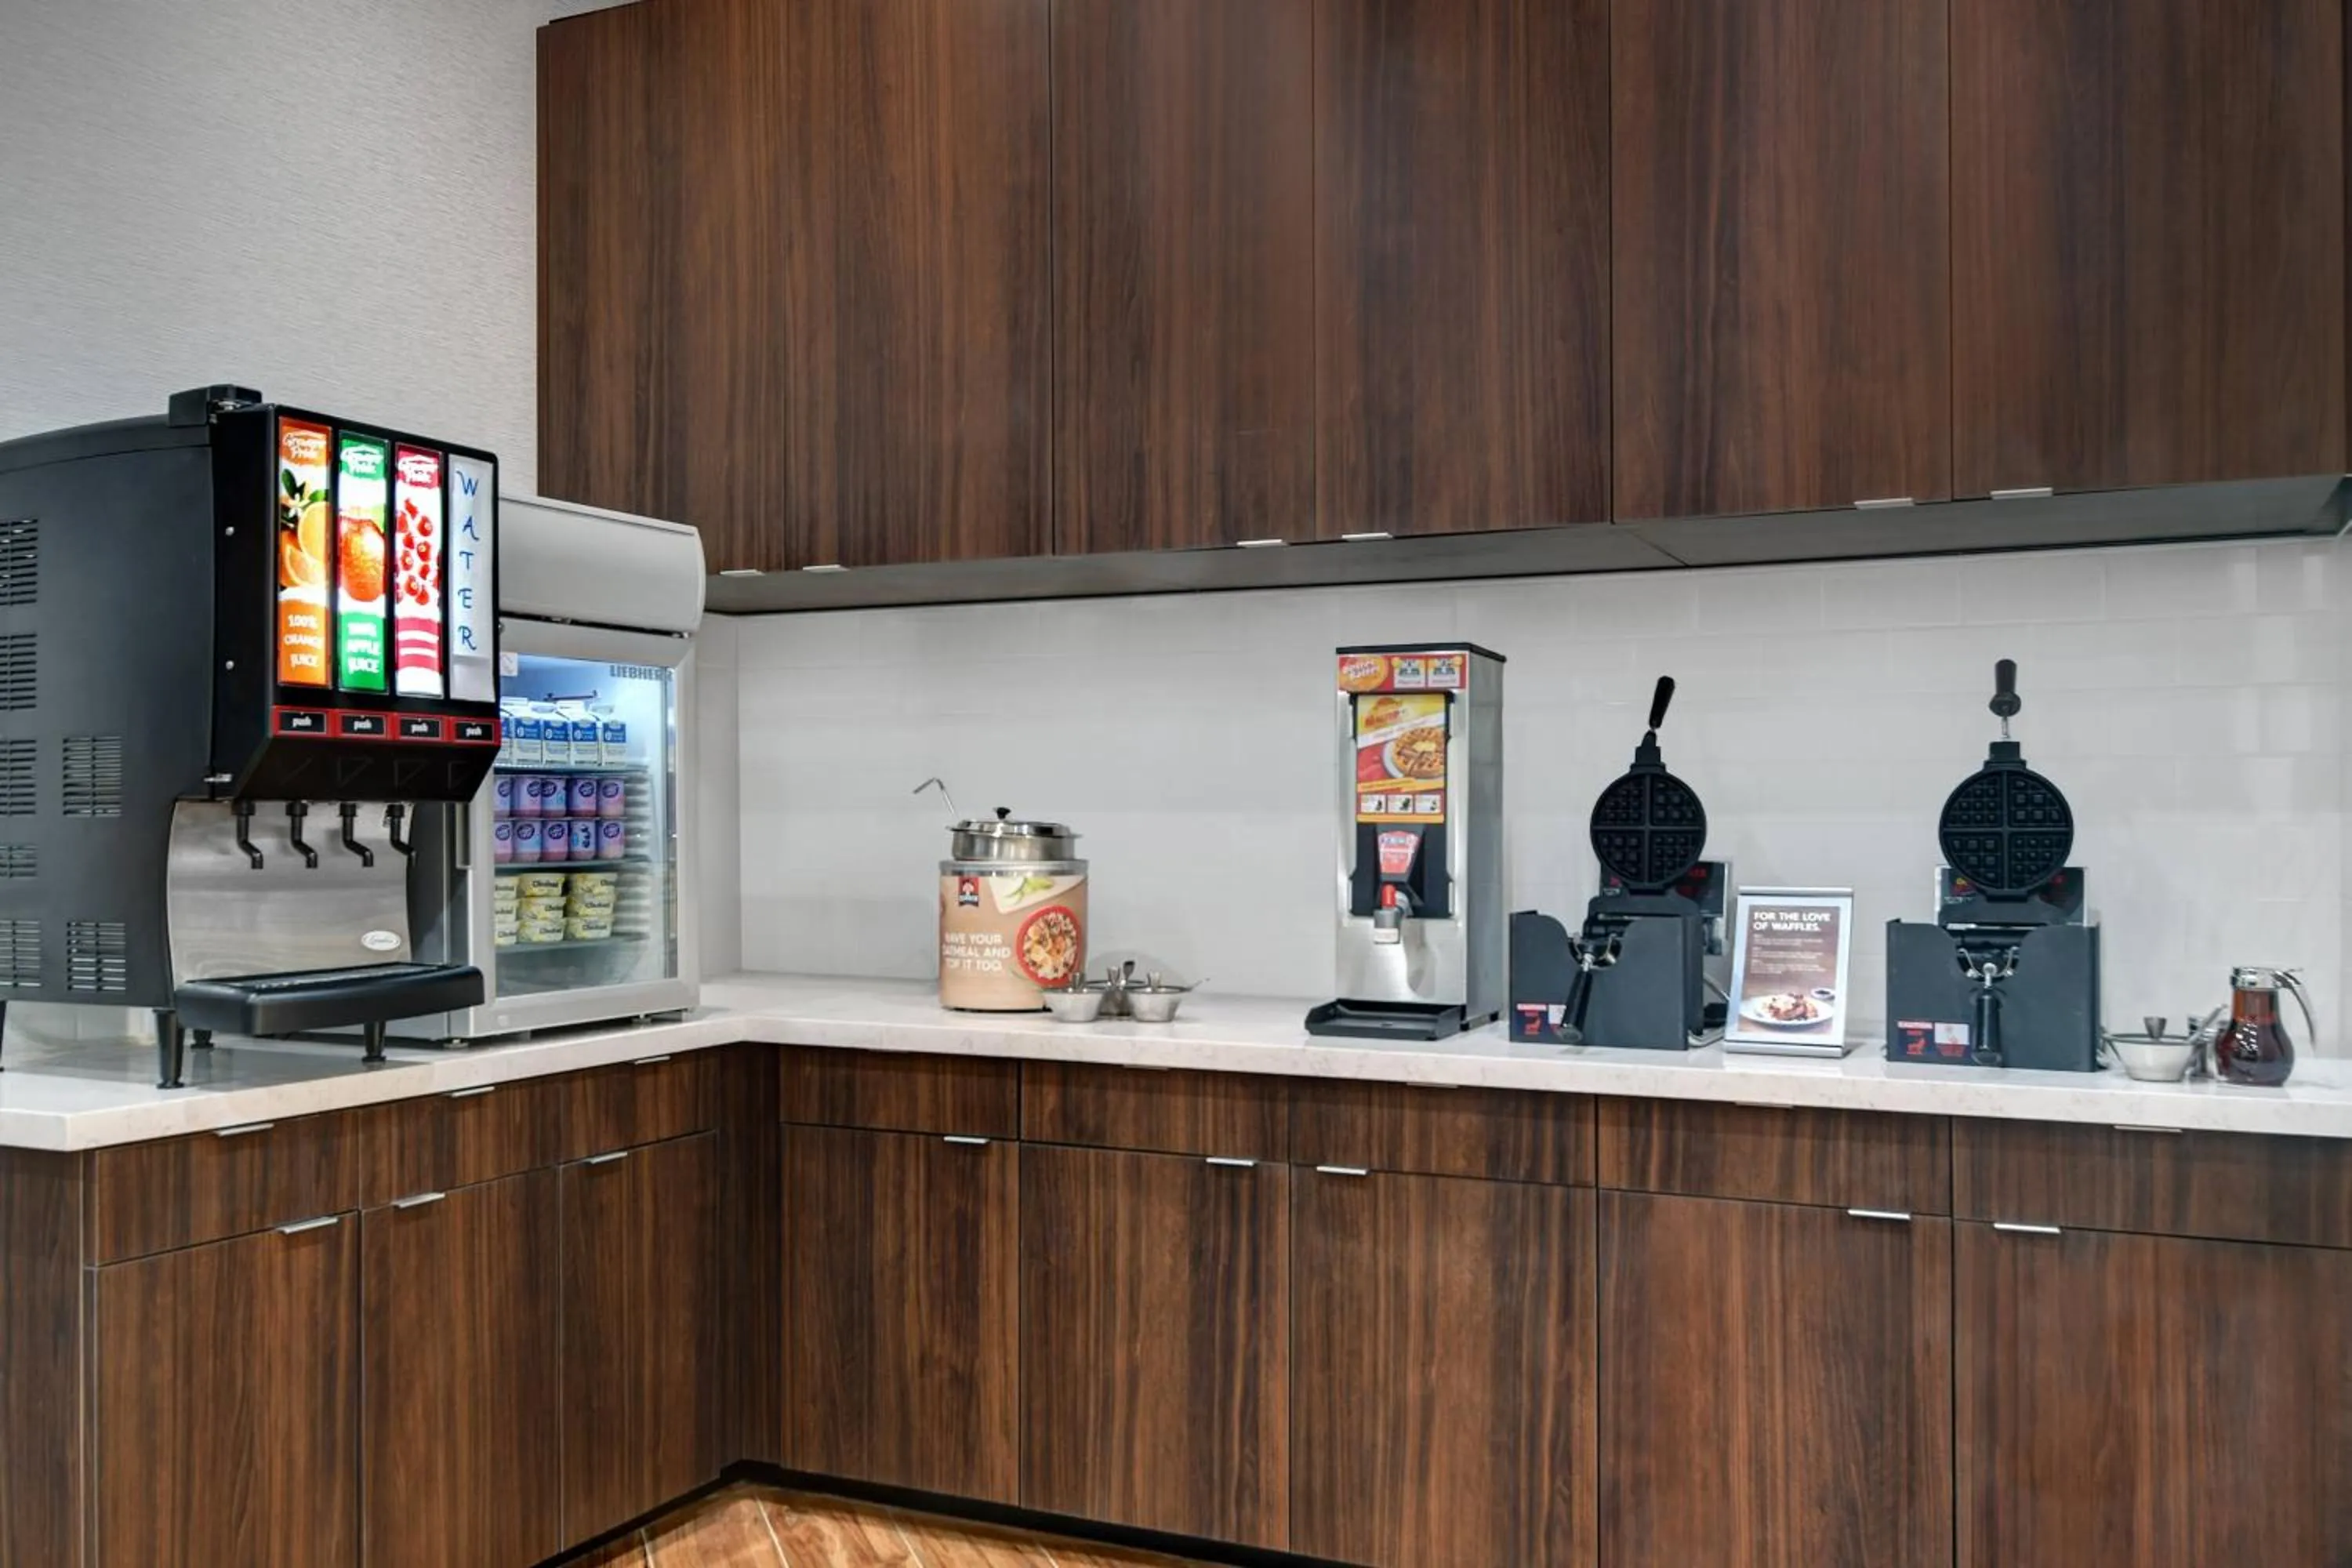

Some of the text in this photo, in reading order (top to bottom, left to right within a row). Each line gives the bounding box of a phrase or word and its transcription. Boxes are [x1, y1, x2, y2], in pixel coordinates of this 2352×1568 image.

[456, 470, 480, 651] WATER
[292, 717, 312, 728] push
[354, 720, 372, 731] push
[410, 723, 429, 734] push
[466, 726, 483, 737] push
[1754, 912, 1831, 922] FOR THE LOVE
[1753, 921, 1822, 932] OF WAFFLES.
[969, 933, 1004, 945] YOUR
[983, 946, 1011, 959] AND
